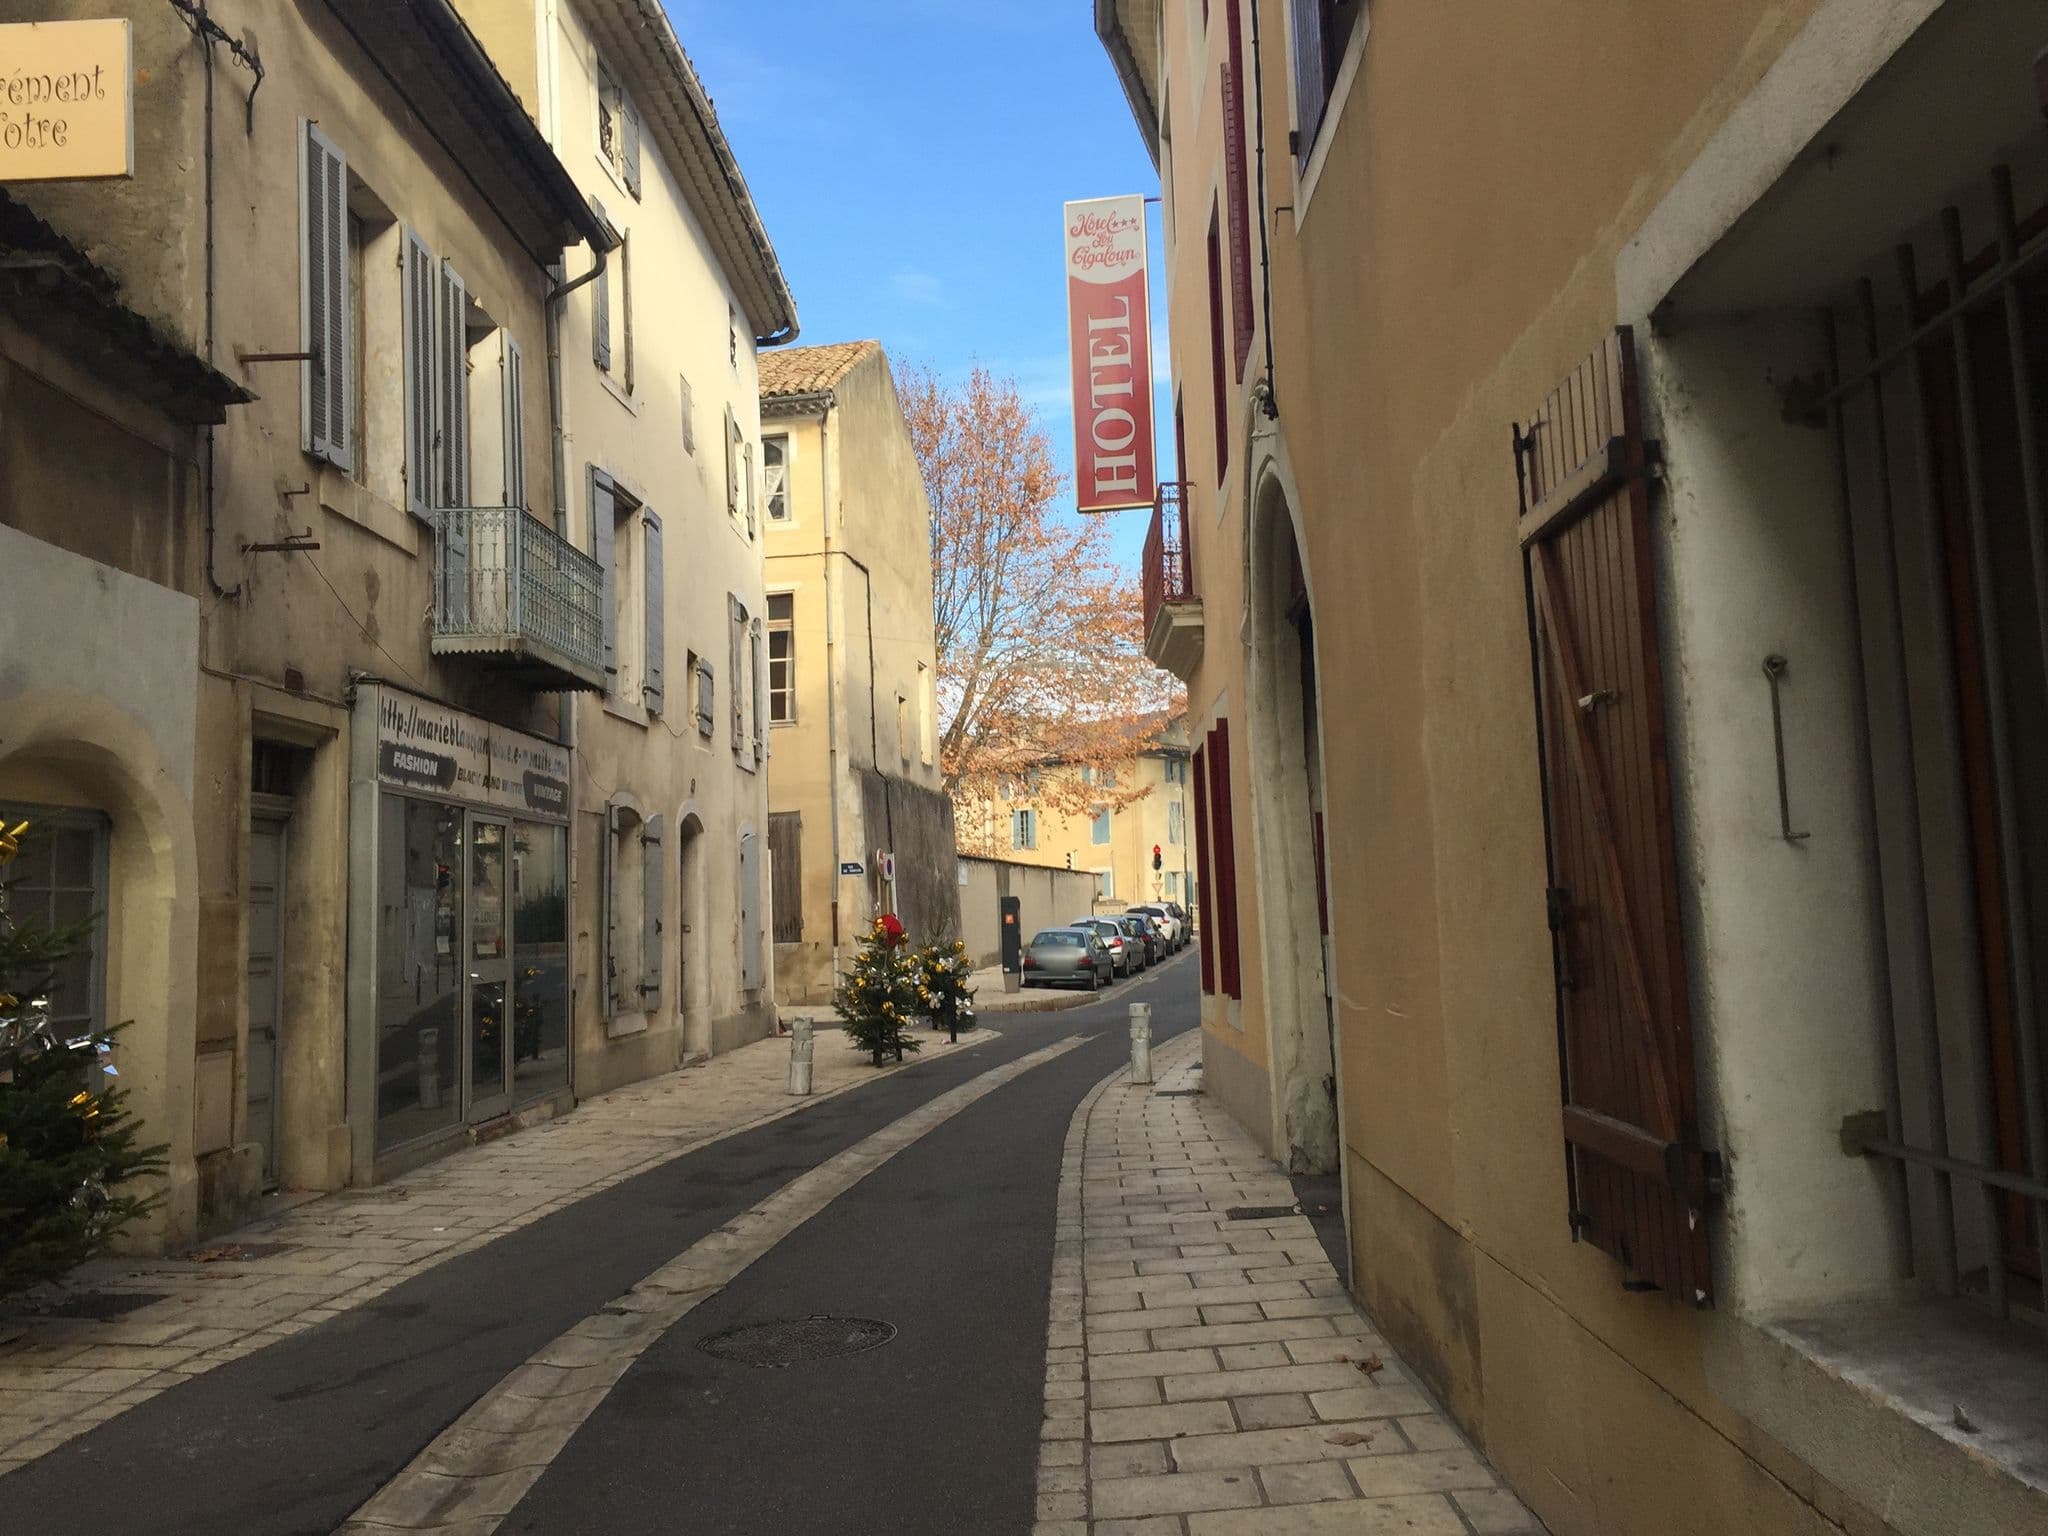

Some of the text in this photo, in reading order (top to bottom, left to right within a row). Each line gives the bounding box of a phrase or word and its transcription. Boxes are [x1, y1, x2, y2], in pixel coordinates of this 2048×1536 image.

[0, 112, 68, 149] otre
[1087, 296, 1138, 497] HOTEL
[393, 751, 438, 776] FASHION
